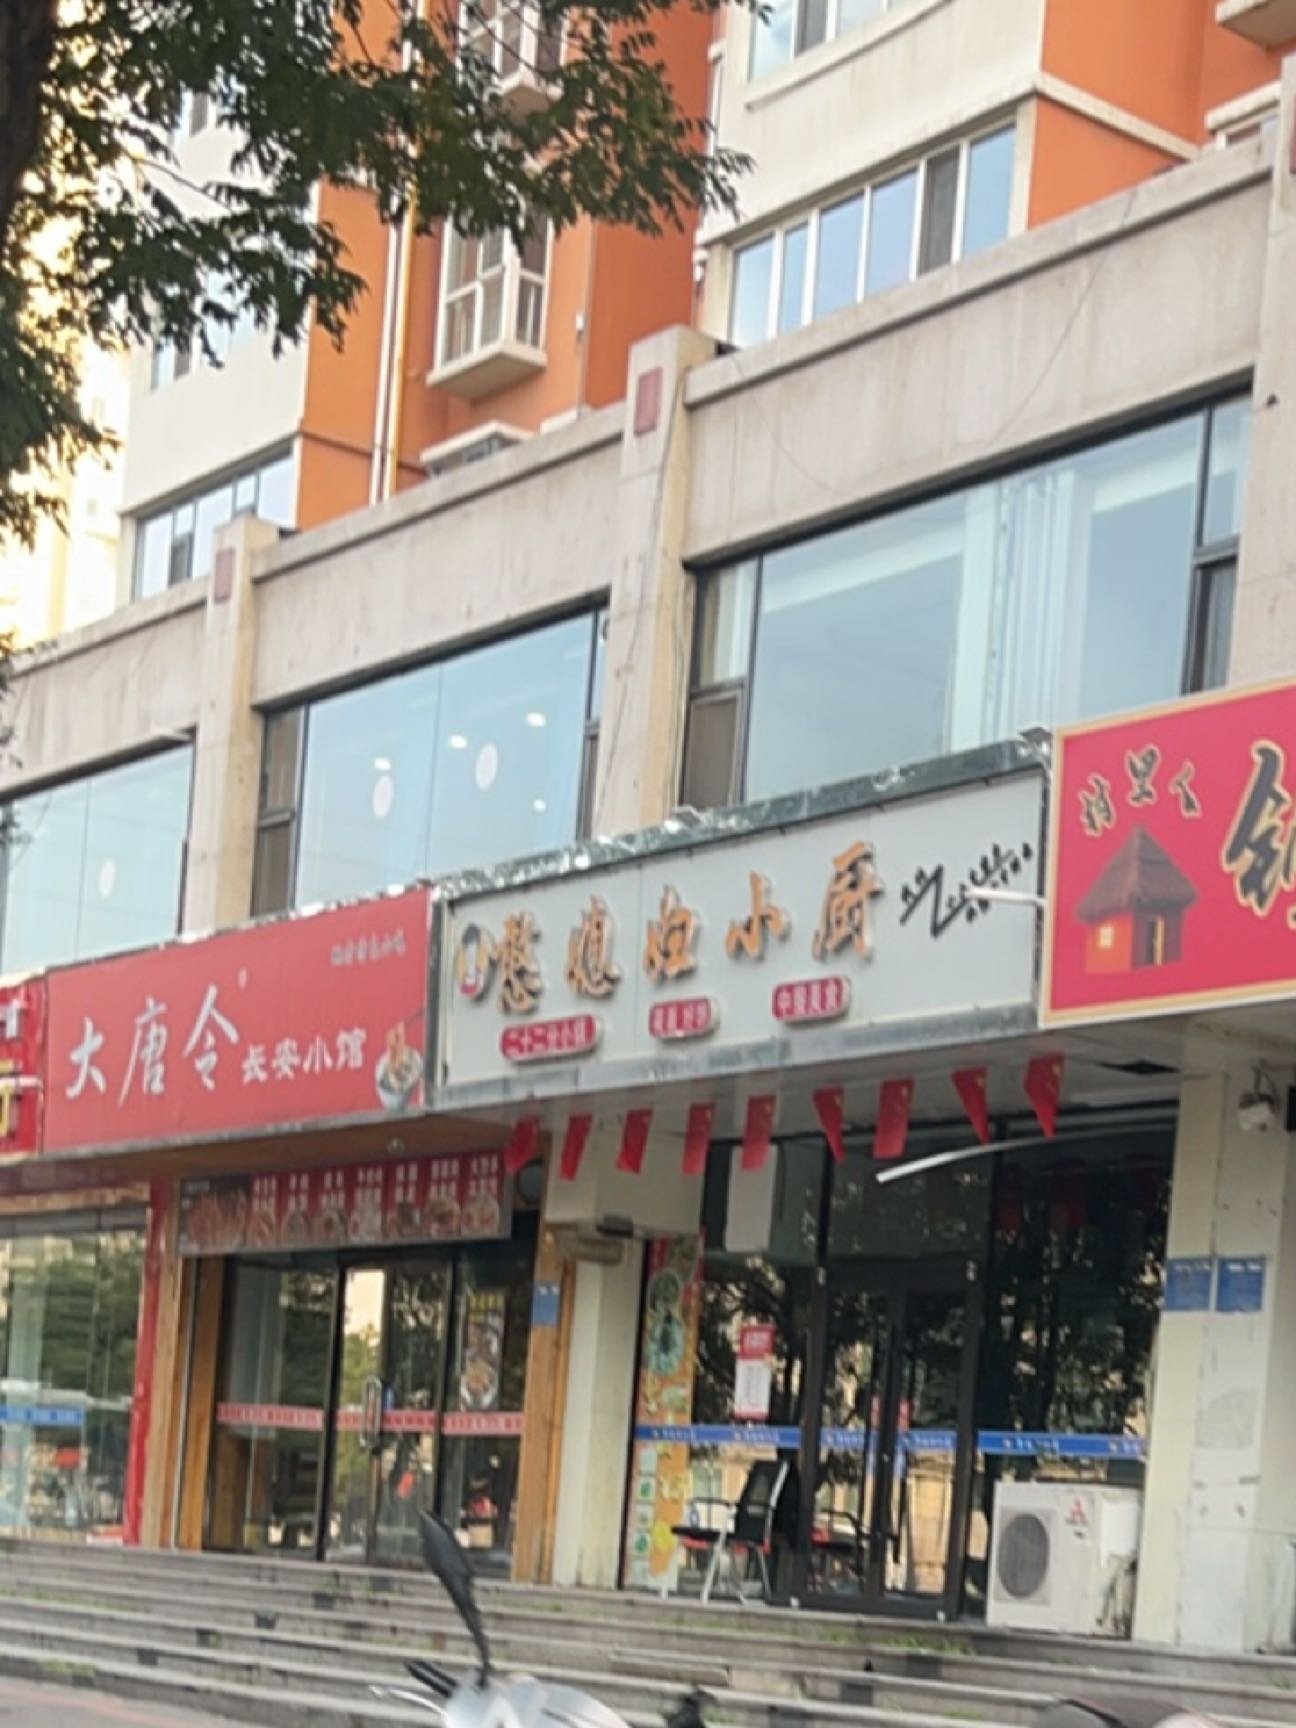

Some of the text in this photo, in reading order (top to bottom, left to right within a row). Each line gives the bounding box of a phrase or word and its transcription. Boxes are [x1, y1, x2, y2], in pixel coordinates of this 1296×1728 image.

[64, 983, 240, 1106] 大唐令
[241, 1027, 366, 1084] 长安小馆
